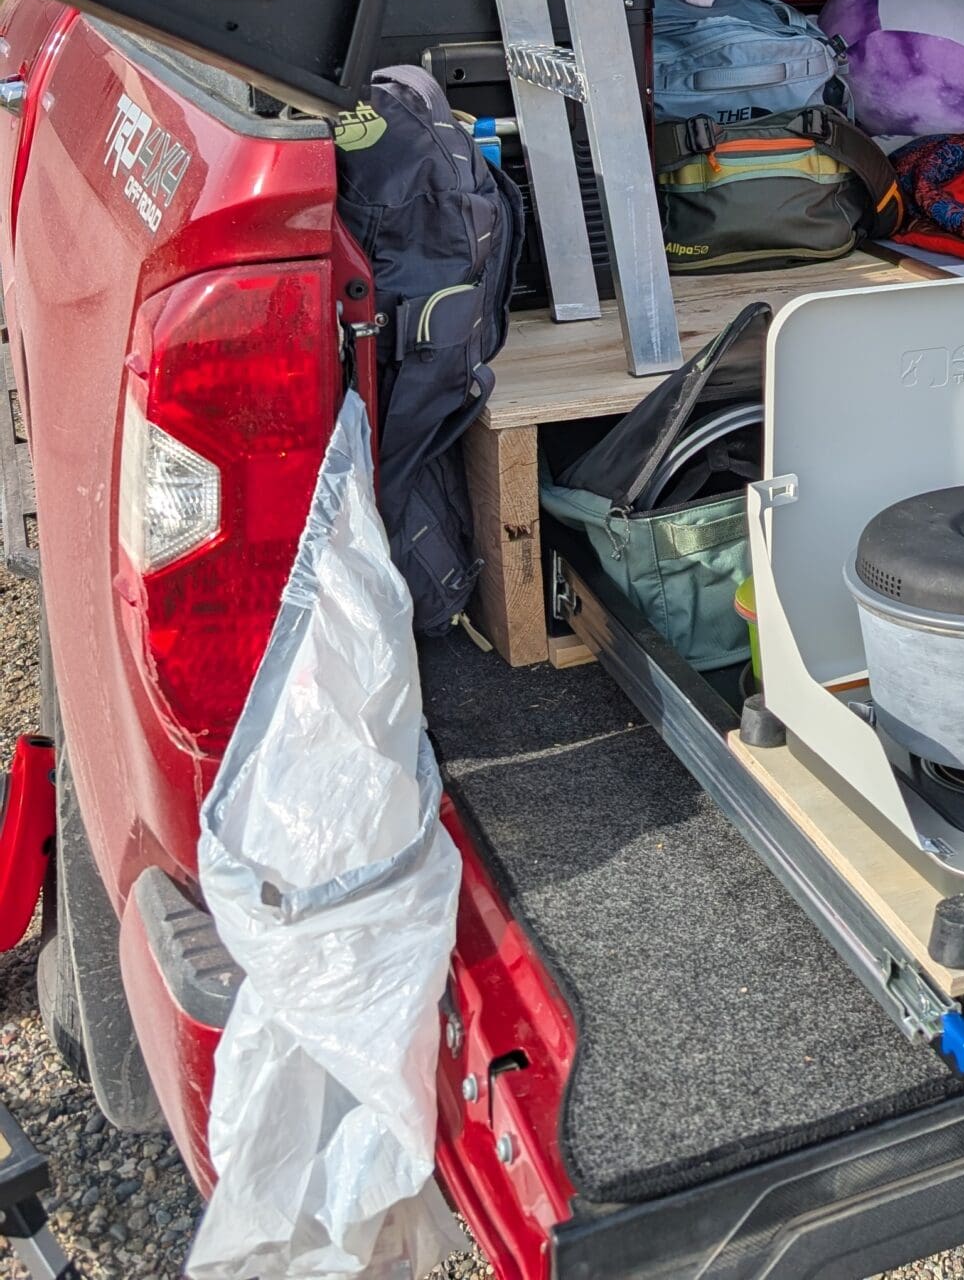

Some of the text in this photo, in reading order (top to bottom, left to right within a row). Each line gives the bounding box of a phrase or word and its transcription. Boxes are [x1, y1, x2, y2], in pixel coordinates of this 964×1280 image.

[104, 93, 152, 178] TRD
[717, 107, 750, 123] THE
[124, 175, 163, 233] OFF ROAD
